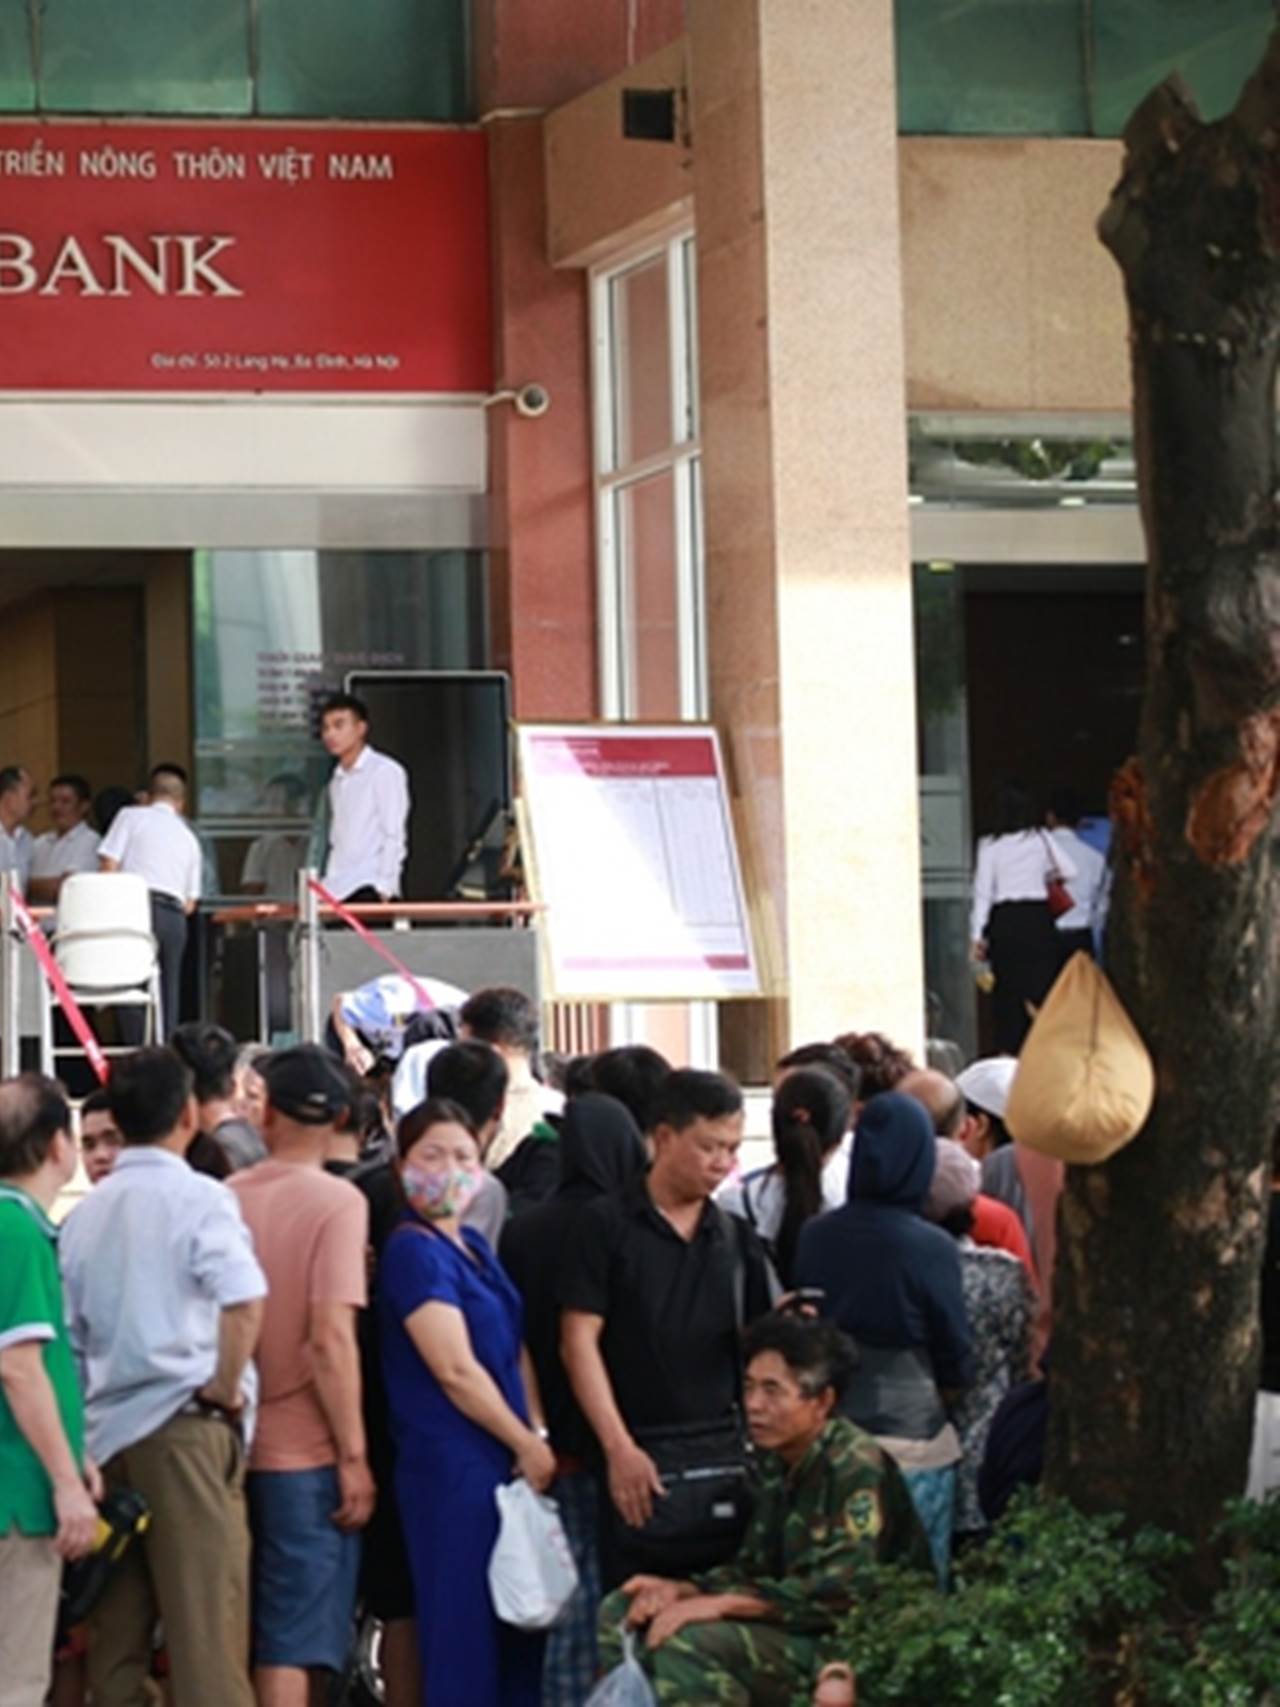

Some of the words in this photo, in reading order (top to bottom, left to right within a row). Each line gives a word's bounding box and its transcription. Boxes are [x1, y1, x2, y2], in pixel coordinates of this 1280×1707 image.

[80, 142, 157, 178] NÔNG
[173, 144, 245, 179] THÔN
[259, 147, 315, 185] VIỆT
[329, 154, 394, 180] NAM
